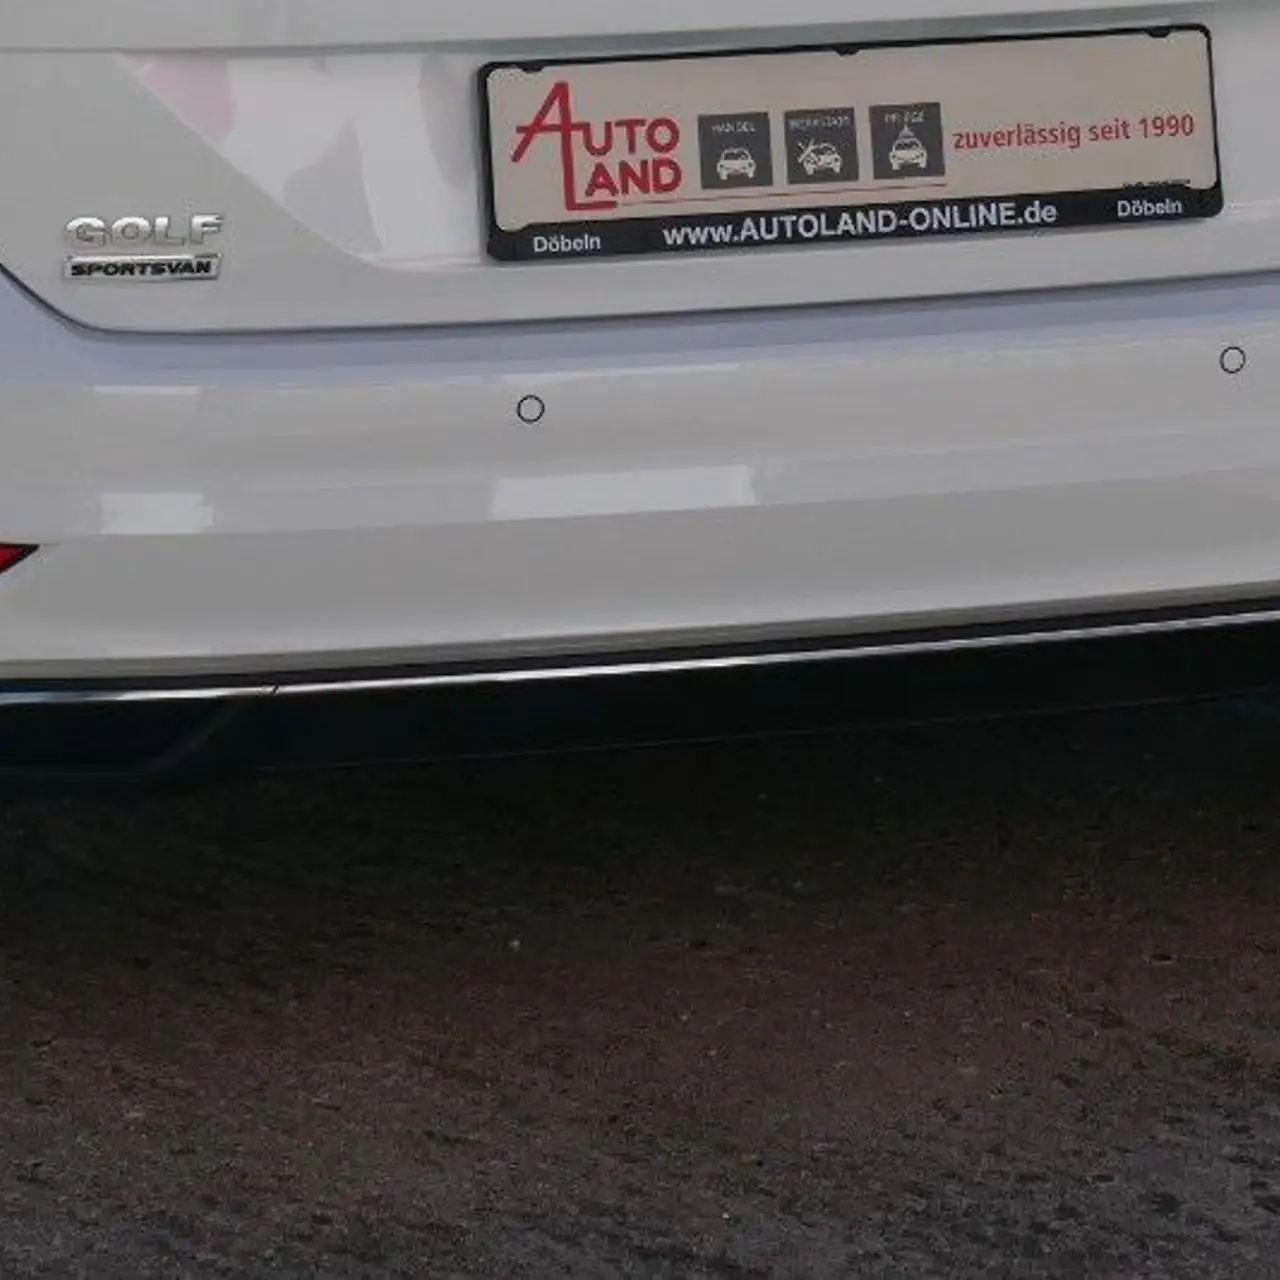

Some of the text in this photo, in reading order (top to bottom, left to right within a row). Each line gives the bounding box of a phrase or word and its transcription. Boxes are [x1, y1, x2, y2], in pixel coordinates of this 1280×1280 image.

[511, 81, 681, 163] AUTO
[952, 112, 1195, 150] zuverlässig seit 1990
[561, 150, 683, 212] LAND
[662, 200, 1059, 247] www.AUTOLAND-ONLINE.de
[1116, 198, 1184, 218] Döbeln
[65, 213, 224, 248] GOLF
[532, 233, 602, 254] Döbeln
[70, 259, 212, 277] SPORTSVAN
